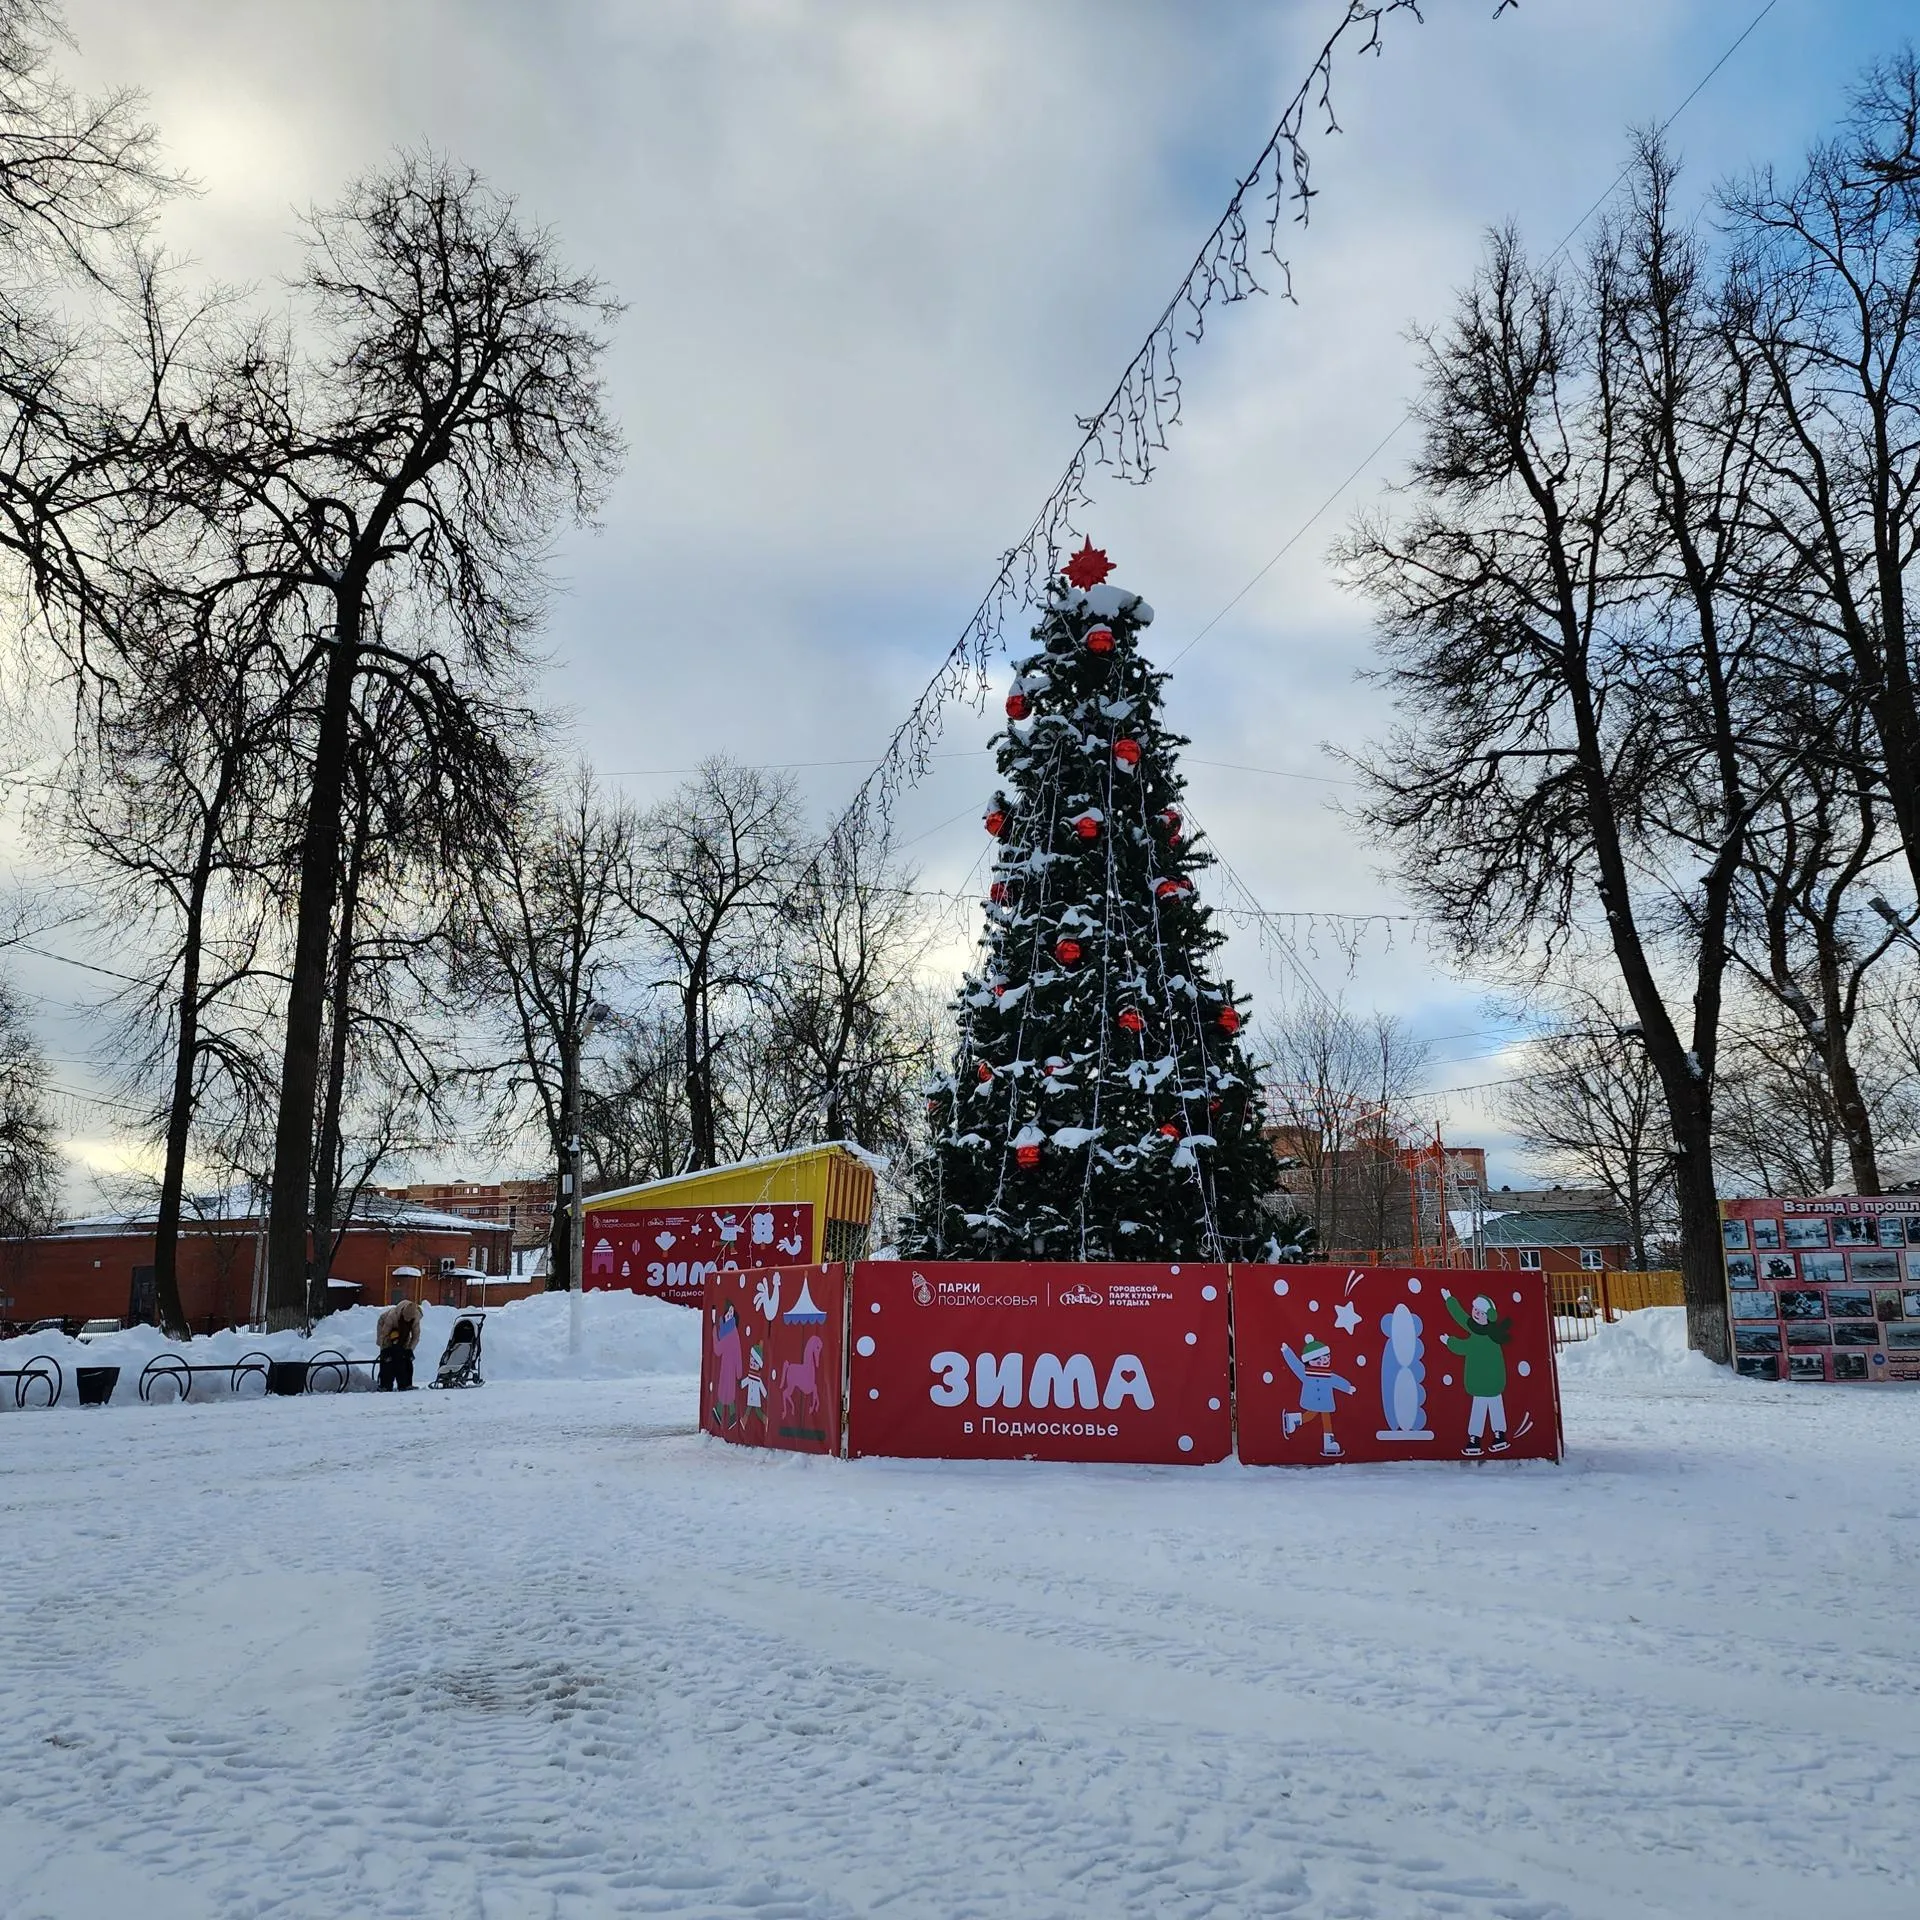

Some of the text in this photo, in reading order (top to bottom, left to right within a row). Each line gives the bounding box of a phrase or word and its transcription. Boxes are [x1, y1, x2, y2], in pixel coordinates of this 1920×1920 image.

[1783, 1201, 1845, 1214] Взгляд
[1850, 1203, 1860, 1212] в
[938, 1283, 981, 1293] ПАРКИ
[938, 1295, 1038, 1306] ПОДМОСКОВЬЯ
[1131, 1292, 1173, 1300] КУЛЬТУРЫ
[1116, 1299, 1150, 1307] ОТДЫХА
[929, 1351, 1155, 1411] ЗИМА
[963, 1417, 1119, 1437] в Подмосковье
